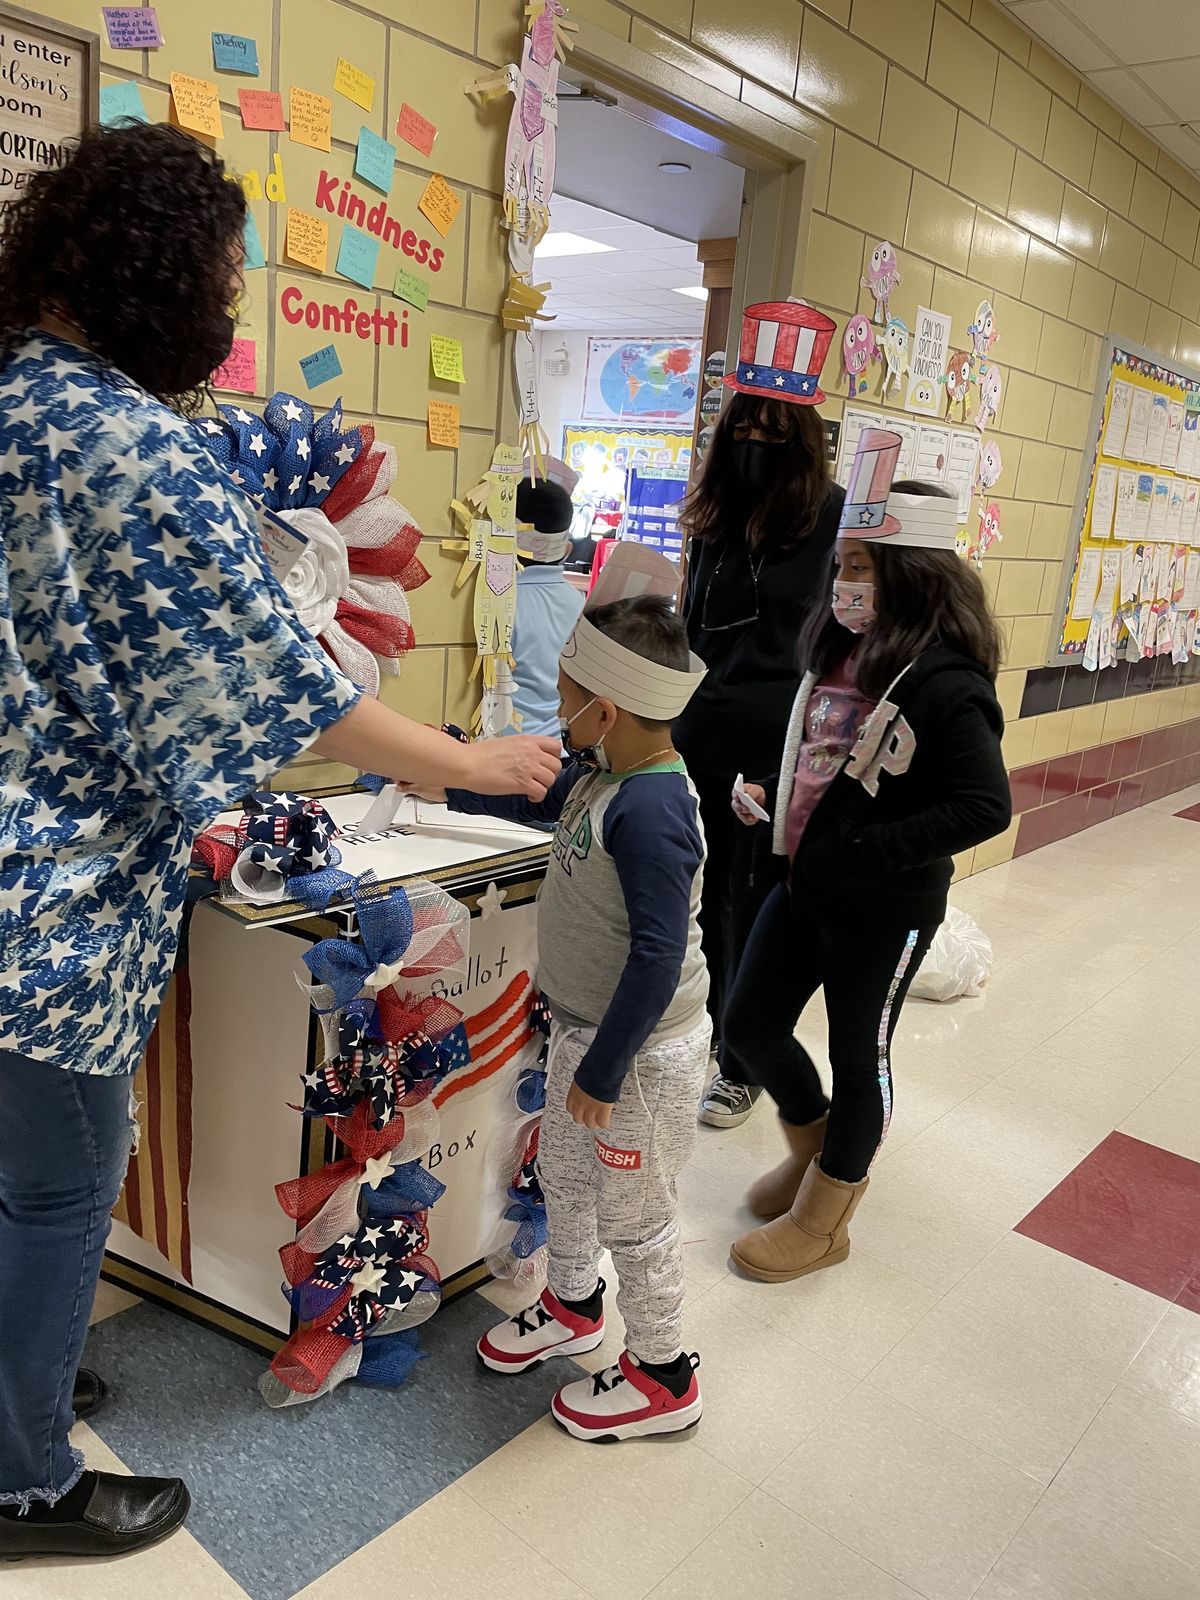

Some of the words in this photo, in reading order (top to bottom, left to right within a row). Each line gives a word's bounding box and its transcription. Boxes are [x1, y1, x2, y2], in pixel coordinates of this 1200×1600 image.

[13, 39, 72, 68] enter
[0, 58, 72, 102] ilson's
[172, 73, 195, 86] Class
[292, 88, 312, 99] Class
[223, 152, 287, 203] ad
[289, 208, 309, 220] Class
[315, 170, 445, 272] Kindness
[281, 287, 409, 348] Confetti
[921, 317, 933, 337] CAN
[933, 321, 945, 341] YOU
[299, 353, 320, 369] David
[919, 338, 931, 358] SPOT
[931, 342, 943, 360] OUR
[341, 827, 417, 846] HERE
[430, 946, 508, 1001] Ballot
[428, 1130, 477, 1170] Box
